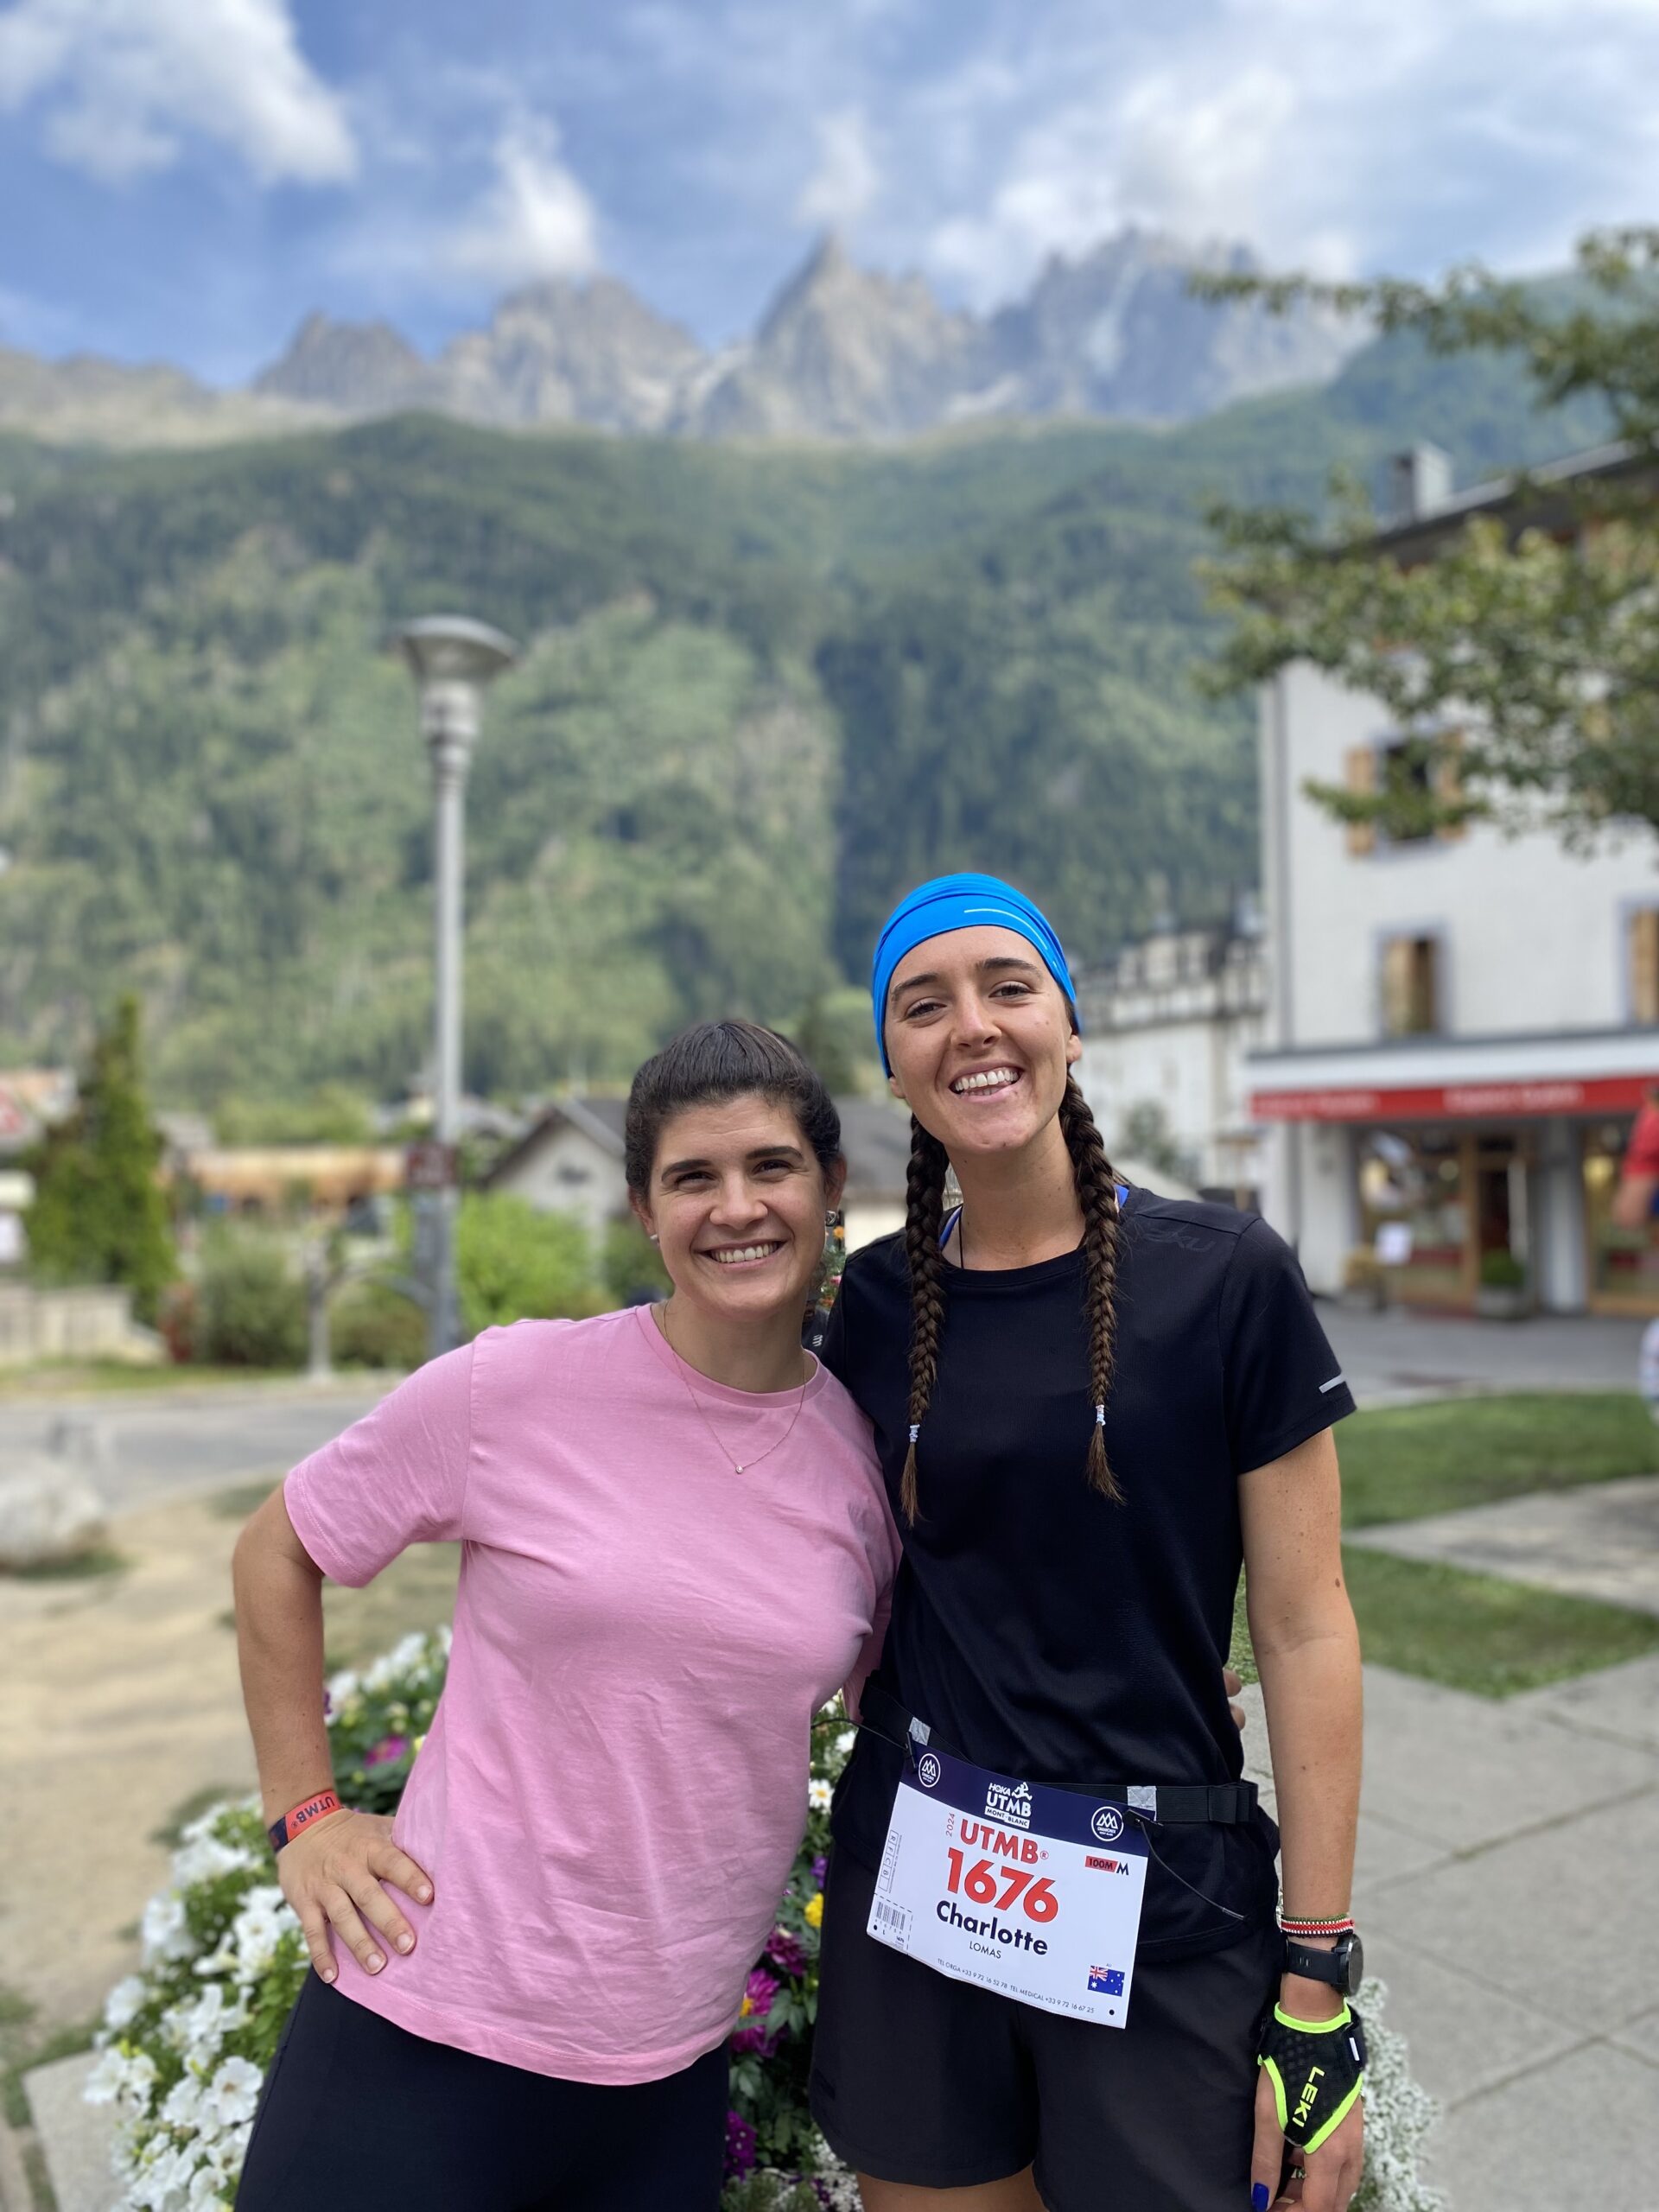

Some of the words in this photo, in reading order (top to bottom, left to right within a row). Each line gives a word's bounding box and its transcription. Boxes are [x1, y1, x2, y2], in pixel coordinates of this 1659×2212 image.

[986, 1790, 1032, 1817] UTMB
[988, 1783, 1011, 1796] HOKA
[945, 1813, 956, 1838] 2024
[947, 1847, 1059, 1923] 1676
[936, 1900, 1048, 1955] Charlotte
[969, 1941, 1002, 1959] LOMAS
[945, 1961, 961, 1974] ORGA
[1020, 1988, 1045, 2002] MEDICAL
[1292, 2066, 1325, 2128] LEKI
